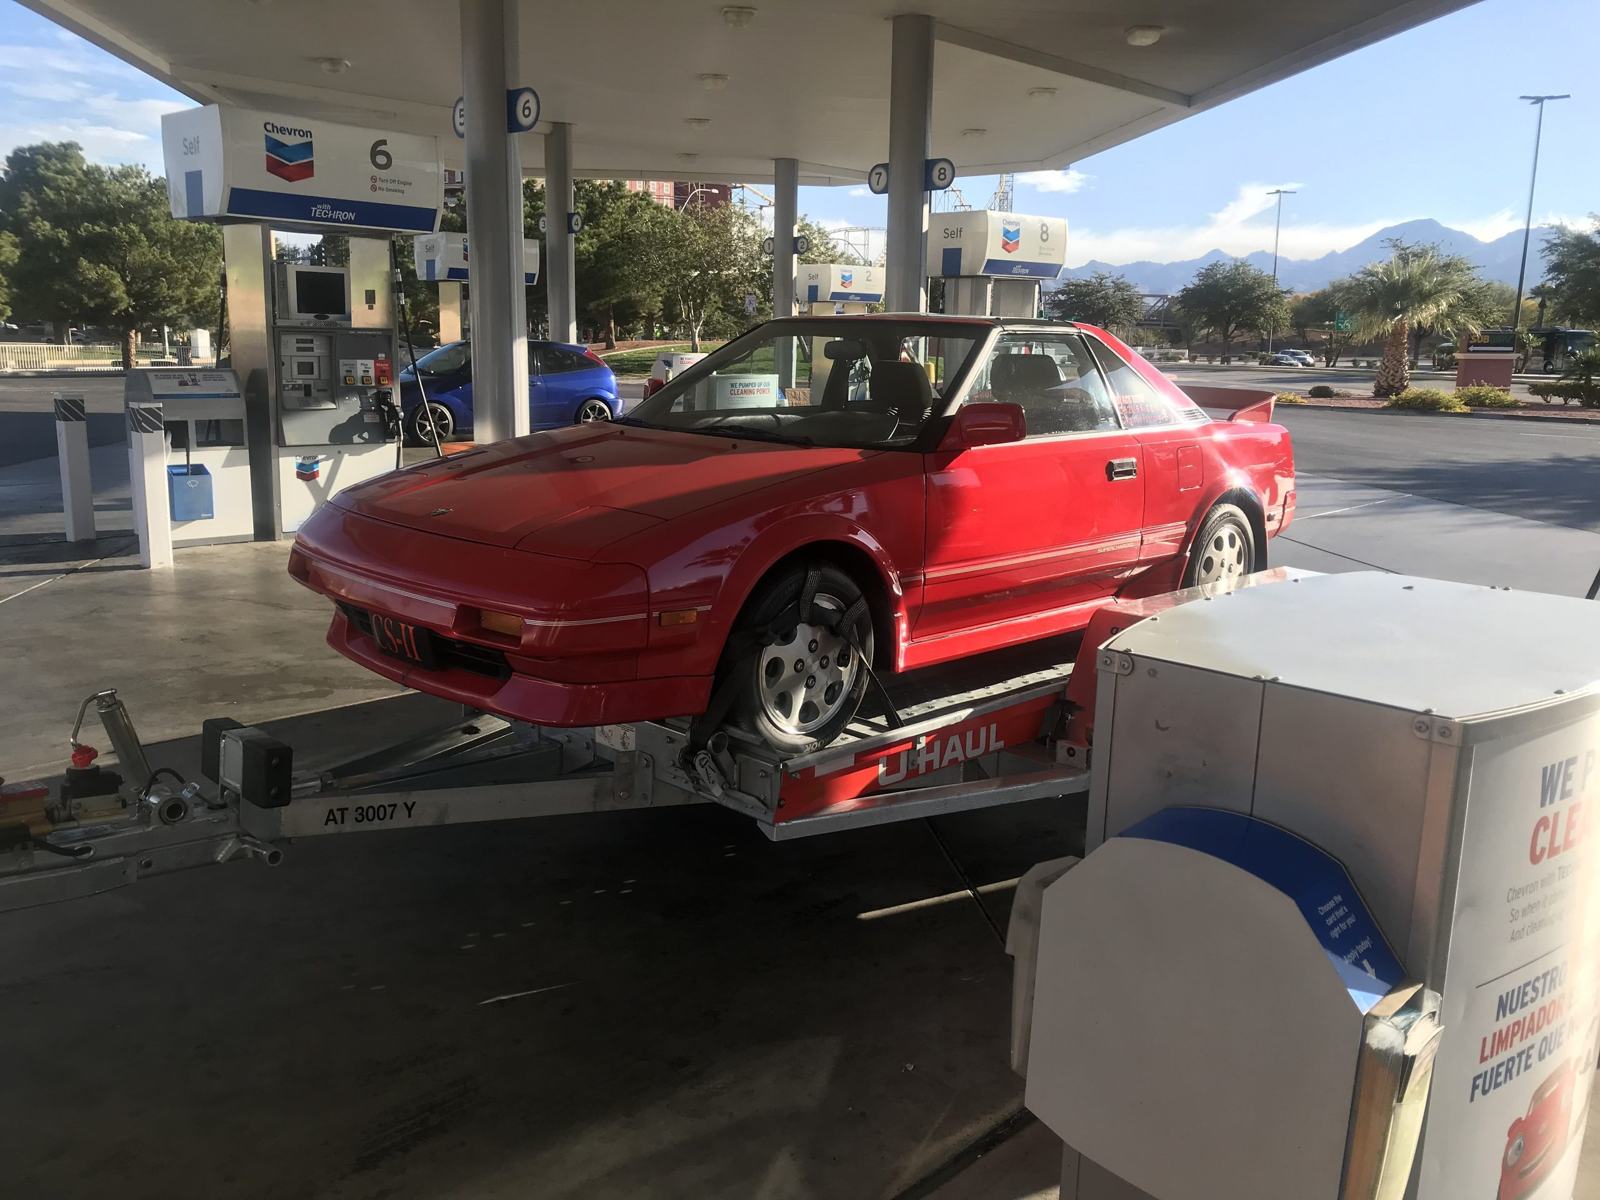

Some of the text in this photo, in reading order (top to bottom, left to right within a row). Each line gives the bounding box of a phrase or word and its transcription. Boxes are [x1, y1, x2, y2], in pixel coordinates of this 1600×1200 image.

[521, 98, 532, 119] 6
[263, 121, 313, 139] Chevron
[182, 136, 201, 157] Self
[369, 139, 393, 170] 6
[874, 171, 883, 186] 7
[937, 167, 947, 181] 8
[310, 207, 356, 222] TECHRON
[317, 203, 331, 211] with
[540, 218, 547, 229] 3
[573, 217, 580, 228] 4
[943, 227, 963, 239] Self
[1040, 222, 1050, 243] 8
[800, 240, 806, 249] 2
[808, 273, 819, 281] Self
[865, 270, 872, 282] 2
[730, 388, 755, 396] CLEANING
[1540, 756, 1578, 808] WE
[324, 801, 416, 826] AT 3007 Y
[1506, 880, 1539, 904] Chevron
[1509, 908, 1520, 924] So
[1495, 960, 1568, 1022] NUESTRO
[1479, 993, 1566, 1064] LIMPIADOR
[1469, 1043, 1535, 1103] FUERTE
[1538, 1022, 1567, 1062] QUE
